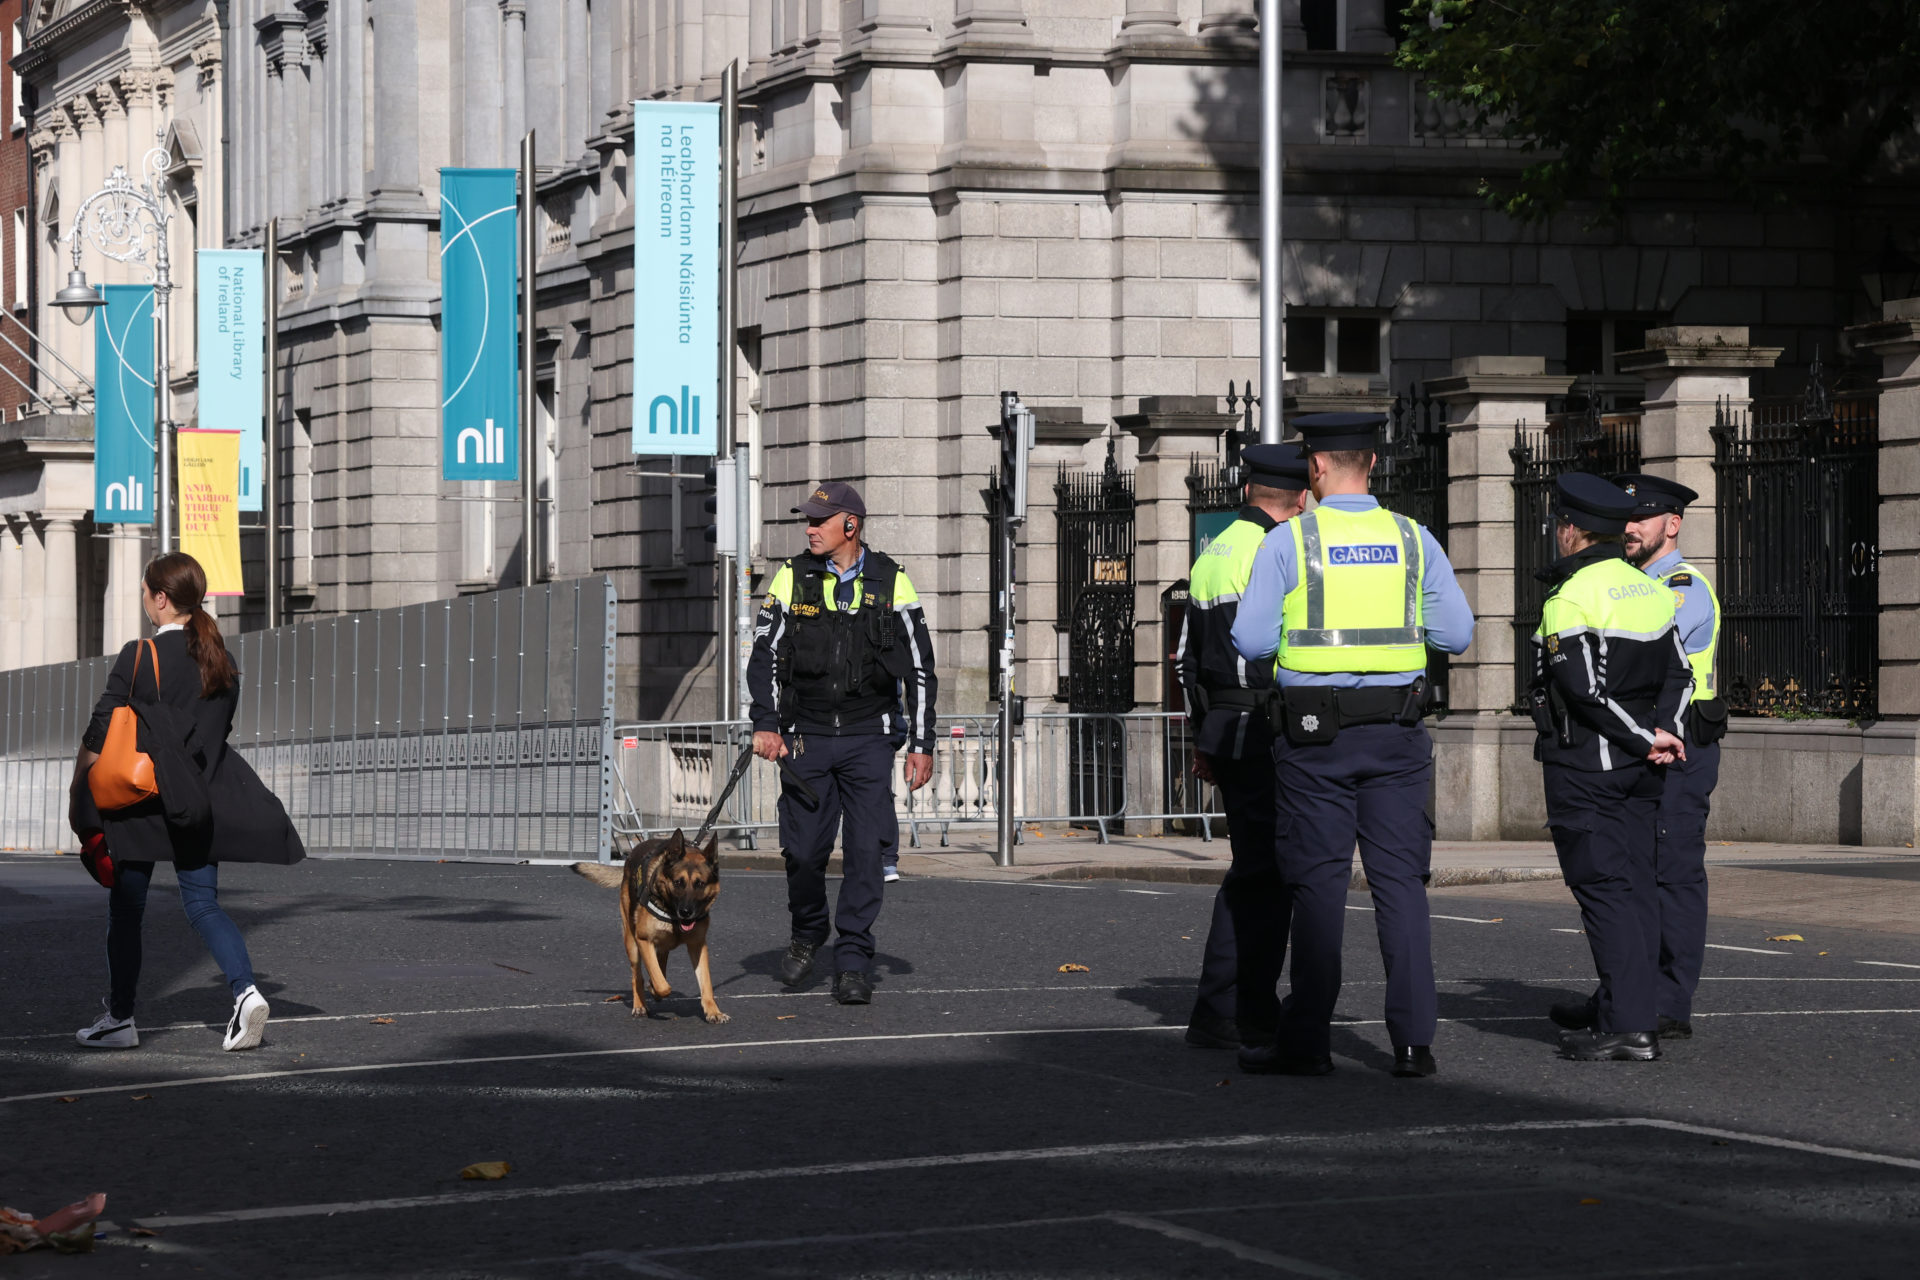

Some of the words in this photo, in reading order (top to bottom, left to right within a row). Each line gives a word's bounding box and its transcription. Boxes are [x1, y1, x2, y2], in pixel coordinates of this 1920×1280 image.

[661, 125, 672, 147] na
[680, 126, 695, 246] Leabharlann
[660, 155, 678, 238] hÉireann
[218, 266, 230, 280] of
[233, 267, 245, 326] National
[679, 253, 695, 344] Náisiúnta
[218, 285, 230, 333] Ireland
[230, 331, 245, 380] Library
[649, 385, 700, 434] nli
[457, 418, 504, 464] nli
[106, 475, 143, 511] nli
[186, 483, 213, 493] ANDY
[185, 493, 232, 503] WARHOL
[185, 503, 221, 512] THREE
[185, 513, 219, 522] TIMES
[185, 523, 208, 532] OUT
[1204, 543, 1233, 558] ARDA
[1332, 547, 1395, 562] GARDA
[1608, 583, 1658, 601] GARDA
[760, 609, 774, 621] RDA
[791, 603, 820, 614] GARDA
